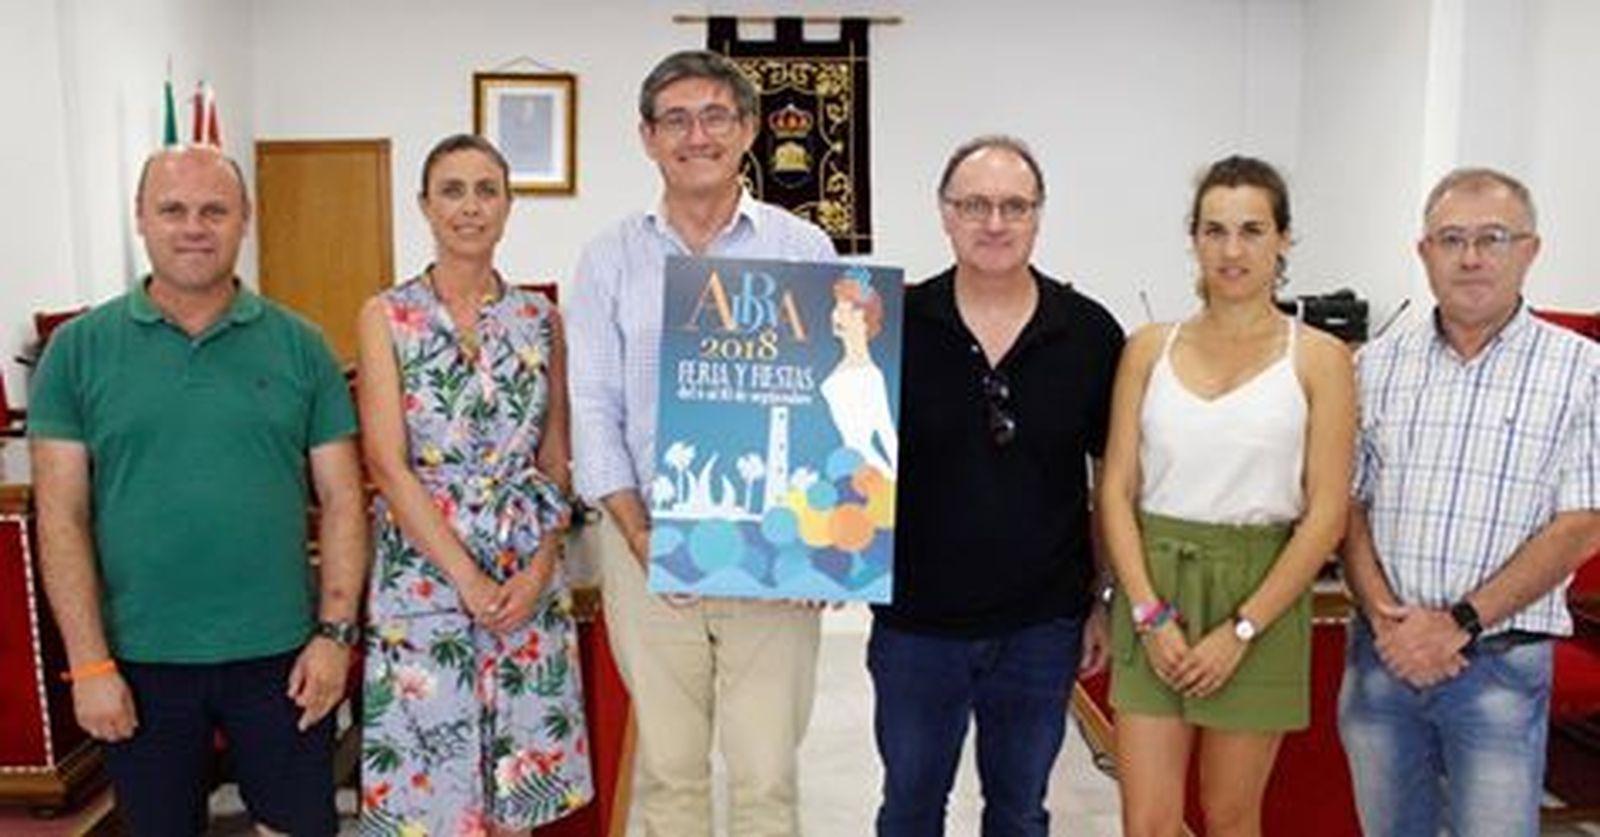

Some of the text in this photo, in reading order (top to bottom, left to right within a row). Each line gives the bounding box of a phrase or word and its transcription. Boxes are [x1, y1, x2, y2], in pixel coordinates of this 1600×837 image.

[700, 330, 778, 360] 2018
[677, 360, 814, 391] FERIA Y FIESTAS
